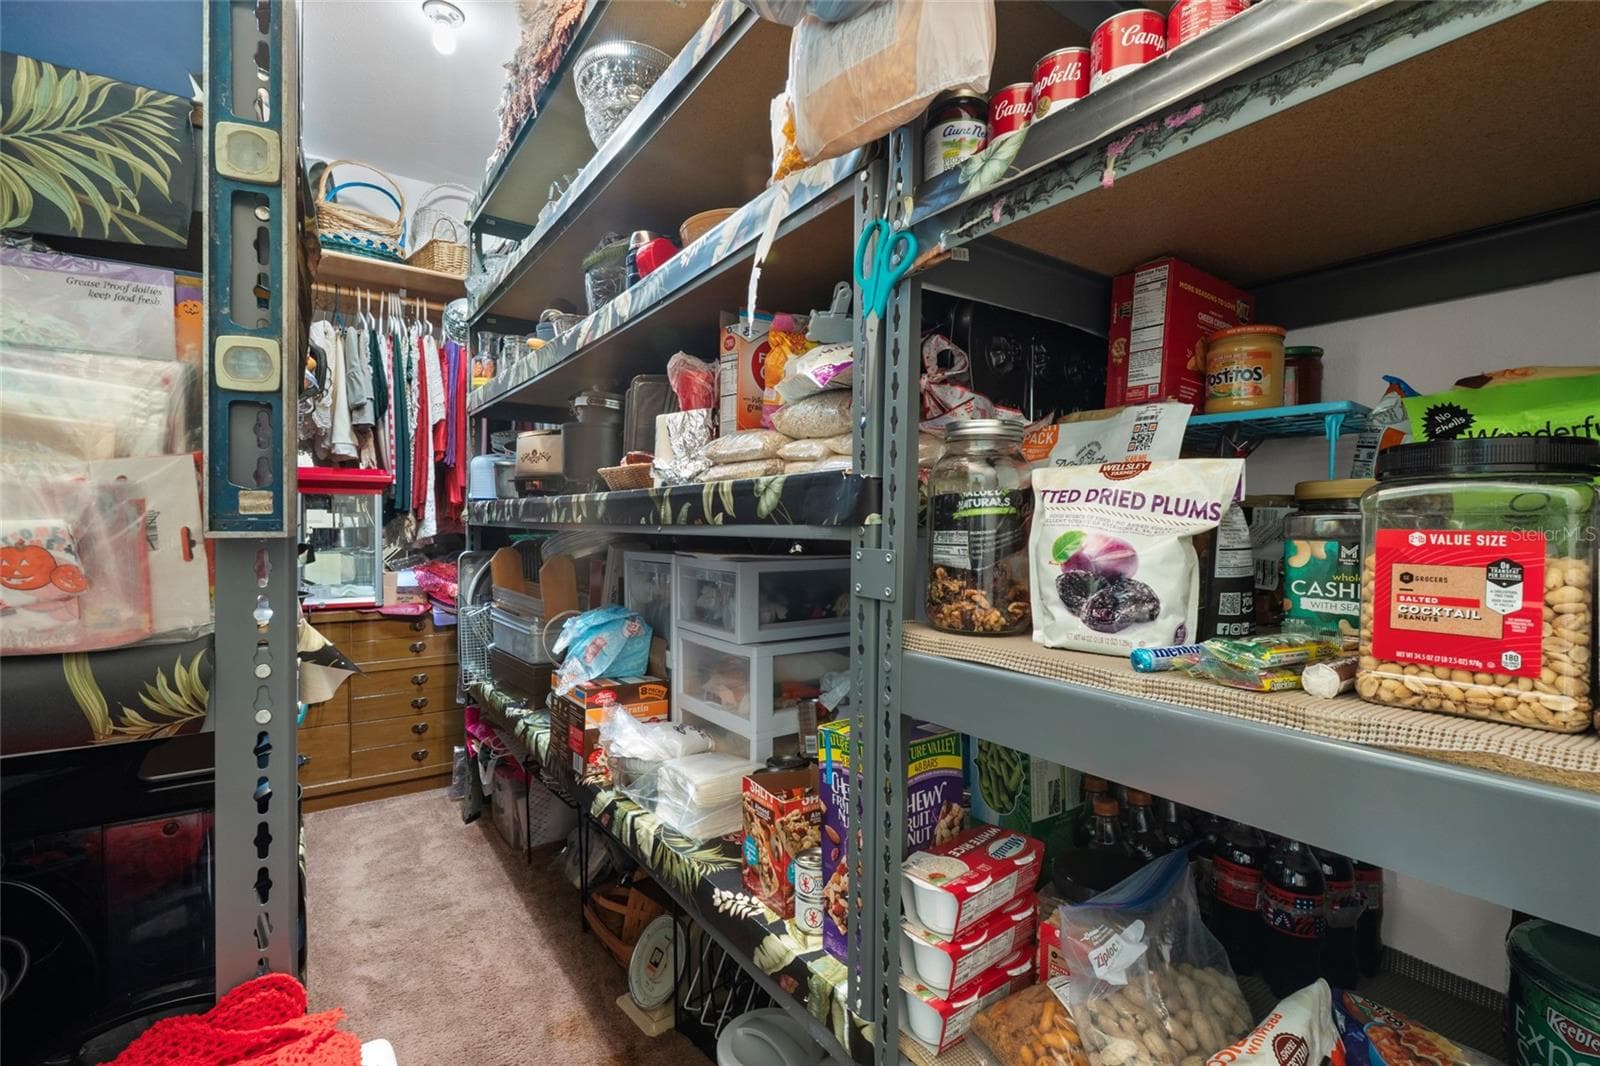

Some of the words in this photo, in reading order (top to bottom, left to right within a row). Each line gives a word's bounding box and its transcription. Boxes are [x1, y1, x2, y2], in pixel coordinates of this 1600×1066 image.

[972, 124, 987, 138] Ne
[65, 276, 101, 288] Grease
[103, 280, 130, 293] Proof
[131, 284, 163, 296] doilies
[88, 289, 111, 300] keep
[114, 292, 136, 303] food
[1434, 412, 1453, 425] No
[1434, 416, 1467, 435] shells
[1101, 461, 1149, 473] WELLSLEY
[1085, 487, 1147, 511] DRIED
[1151, 494, 1223, 522] PLUMS
[1429, 533, 1472, 546] VALUE
[1476, 534, 1508, 547] SIZE
[1332, 572, 1360, 582] whol
[1415, 575, 1449, 584] GROCERS
[1310, 600, 1338, 611] WITH
[1399, 595, 1439, 604] SALTED
[1398, 604, 1482, 621] COCKTAIL
[1398, 613, 1440, 623] PEANUTS
[1504, 654, 1519, 662] 180
[641, 687, 648, 695] 8
[928, 736, 957, 755] VALLEY
[923, 757, 938, 771] BARS
[972, 826, 1001, 847] WHITE
[947, 842, 974, 858] RICE
[1093, 940, 1120, 969] Ziploc
[1247, 1012, 1283, 1056] PREMIUM
